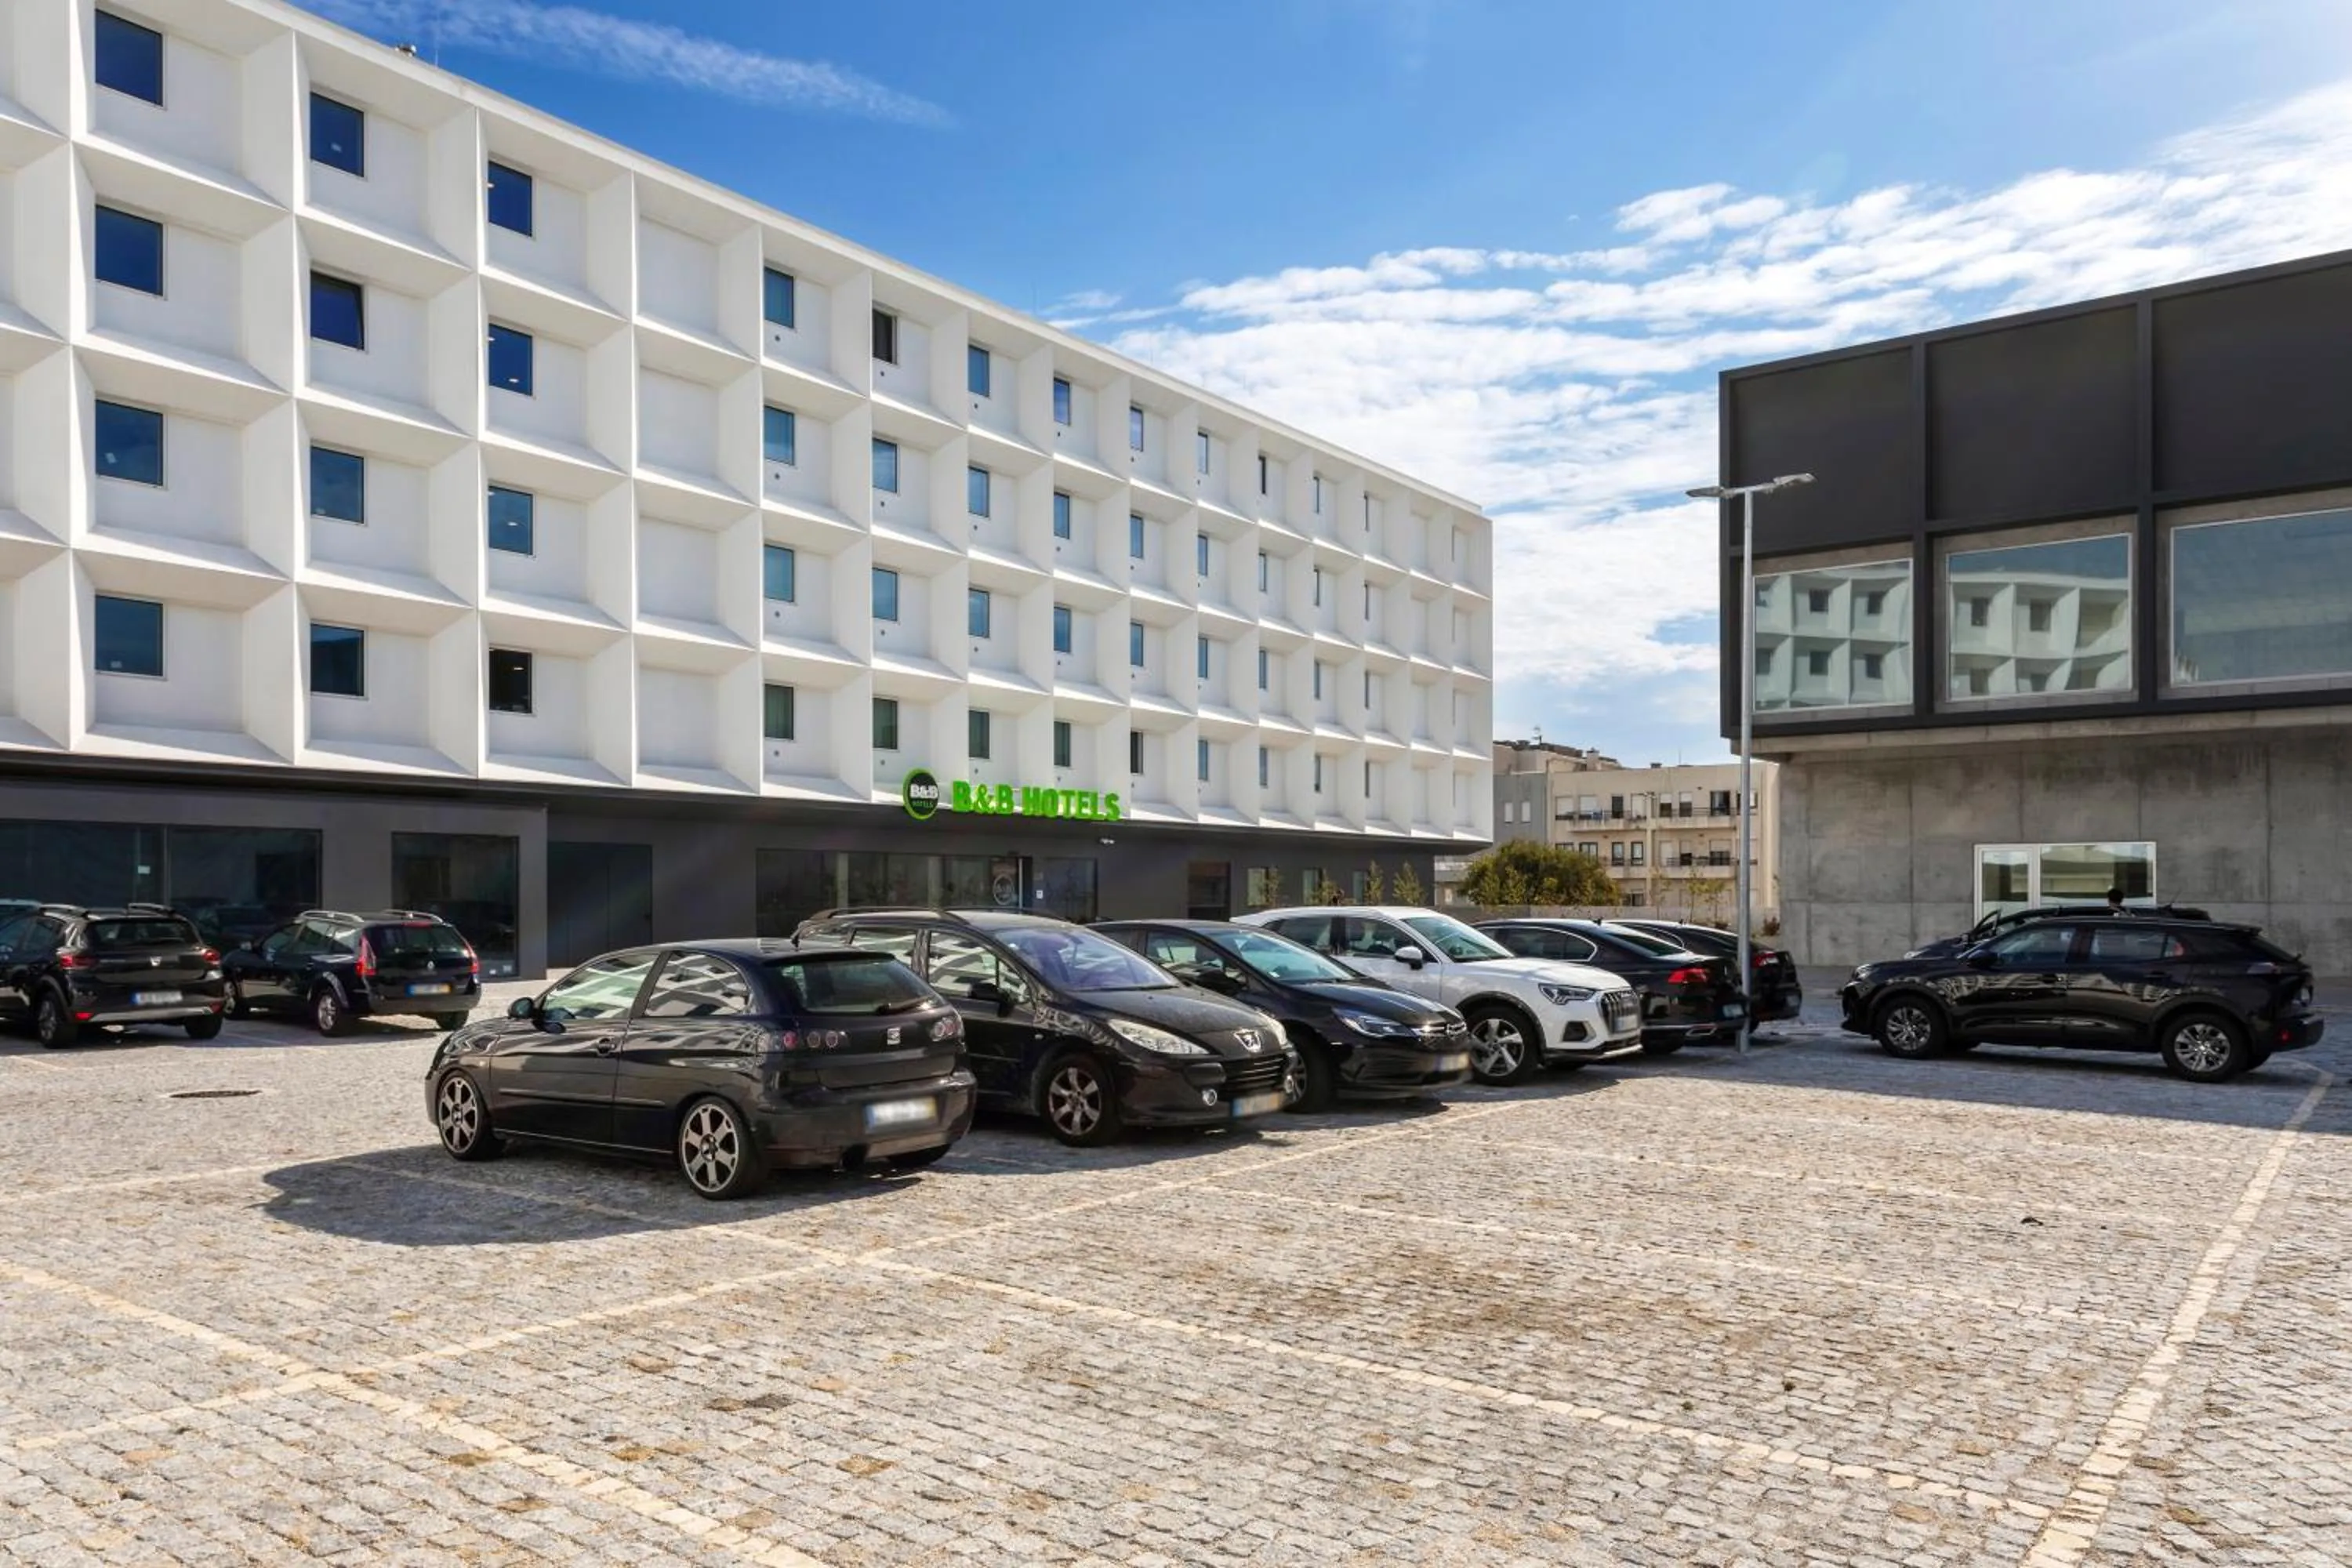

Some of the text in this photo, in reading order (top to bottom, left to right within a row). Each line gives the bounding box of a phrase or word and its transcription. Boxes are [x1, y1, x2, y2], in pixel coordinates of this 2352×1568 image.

[910, 784, 938, 798] B&B
[952, 780, 1120, 820] B&B HOTELS
